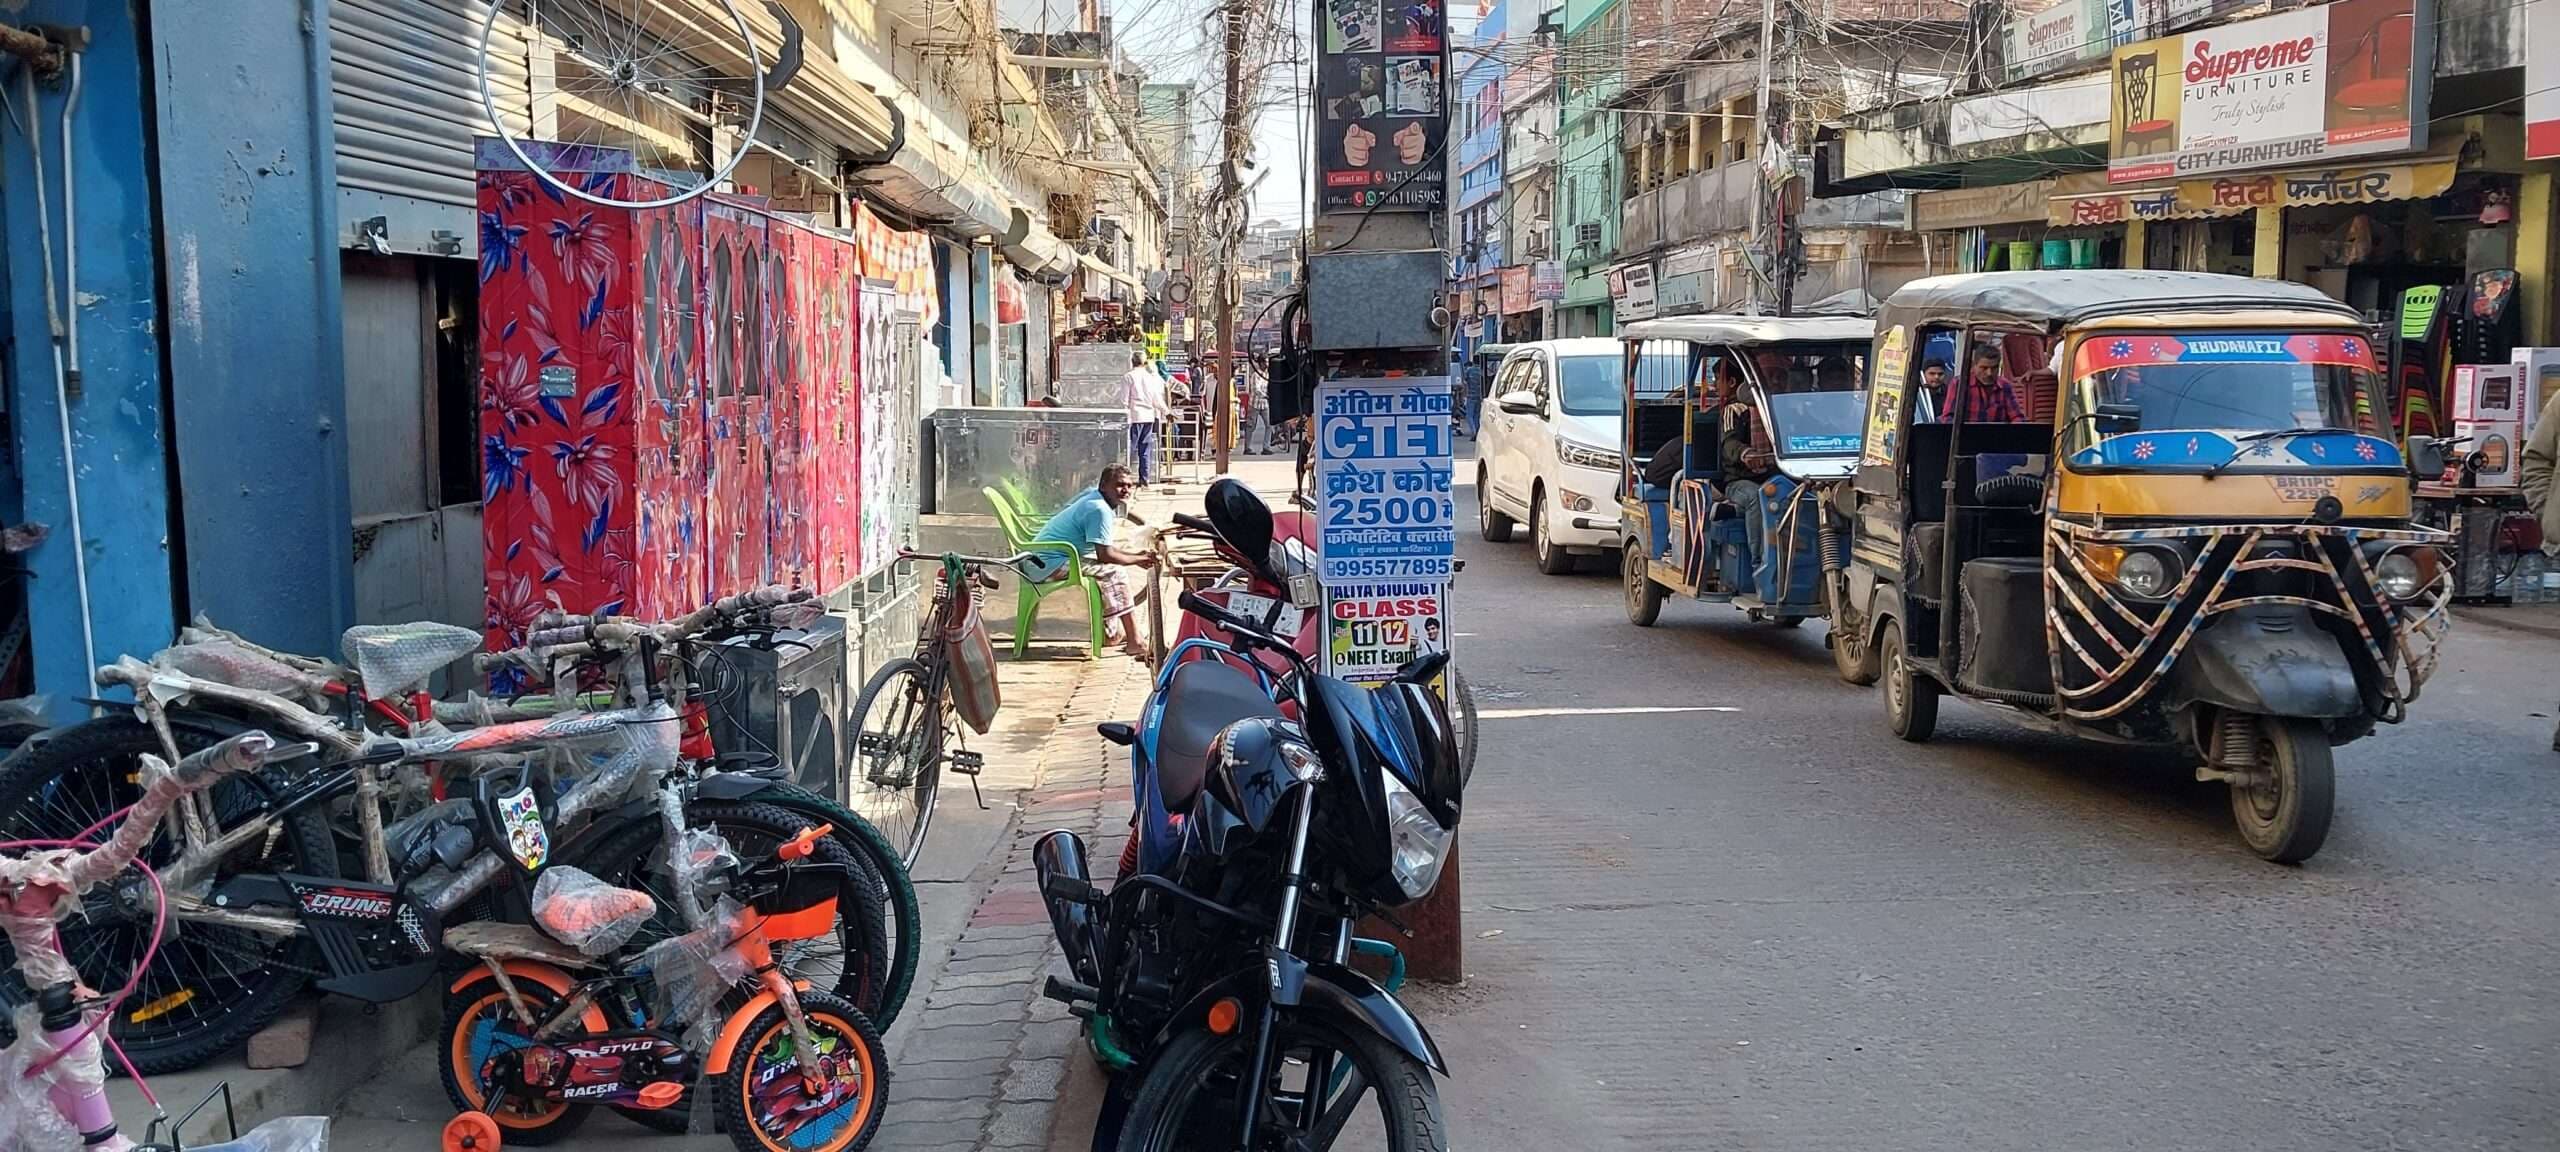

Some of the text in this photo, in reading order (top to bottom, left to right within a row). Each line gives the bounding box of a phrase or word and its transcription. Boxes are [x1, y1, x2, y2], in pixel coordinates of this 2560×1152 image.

[2028, 14, 2073, 48] Supreme
[2185, 37, 2314, 88] Supreme
[2184, 69, 2312, 102] FURNITURE
[2212, 92, 2292, 126] Truly Stylish
[2177, 150, 2215, 170] CITY
[2218, 138, 2326, 166] FURNITURE
[2212, 170, 2392, 208] सिटी फर्नीचर
[2072, 196, 2125, 224] सिटी
[1325, 389, 1394, 414] अंतिम
[1324, 416, 1451, 457] C-TET
[1326, 461, 1385, 498] क्रैश
[2276, 477, 2335, 488] BR11PC
[1329, 498, 1437, 525] 2500
[1336, 559, 1449, 577] 995577895
[1334, 583, 1437, 598] ALIYA BIOLOGY
[1334, 599, 1438, 619] CLASS
[1347, 650, 1377, 666] NEET
[599, 1040, 653, 1055] STYLO
[563, 1082, 619, 1098] RACER
